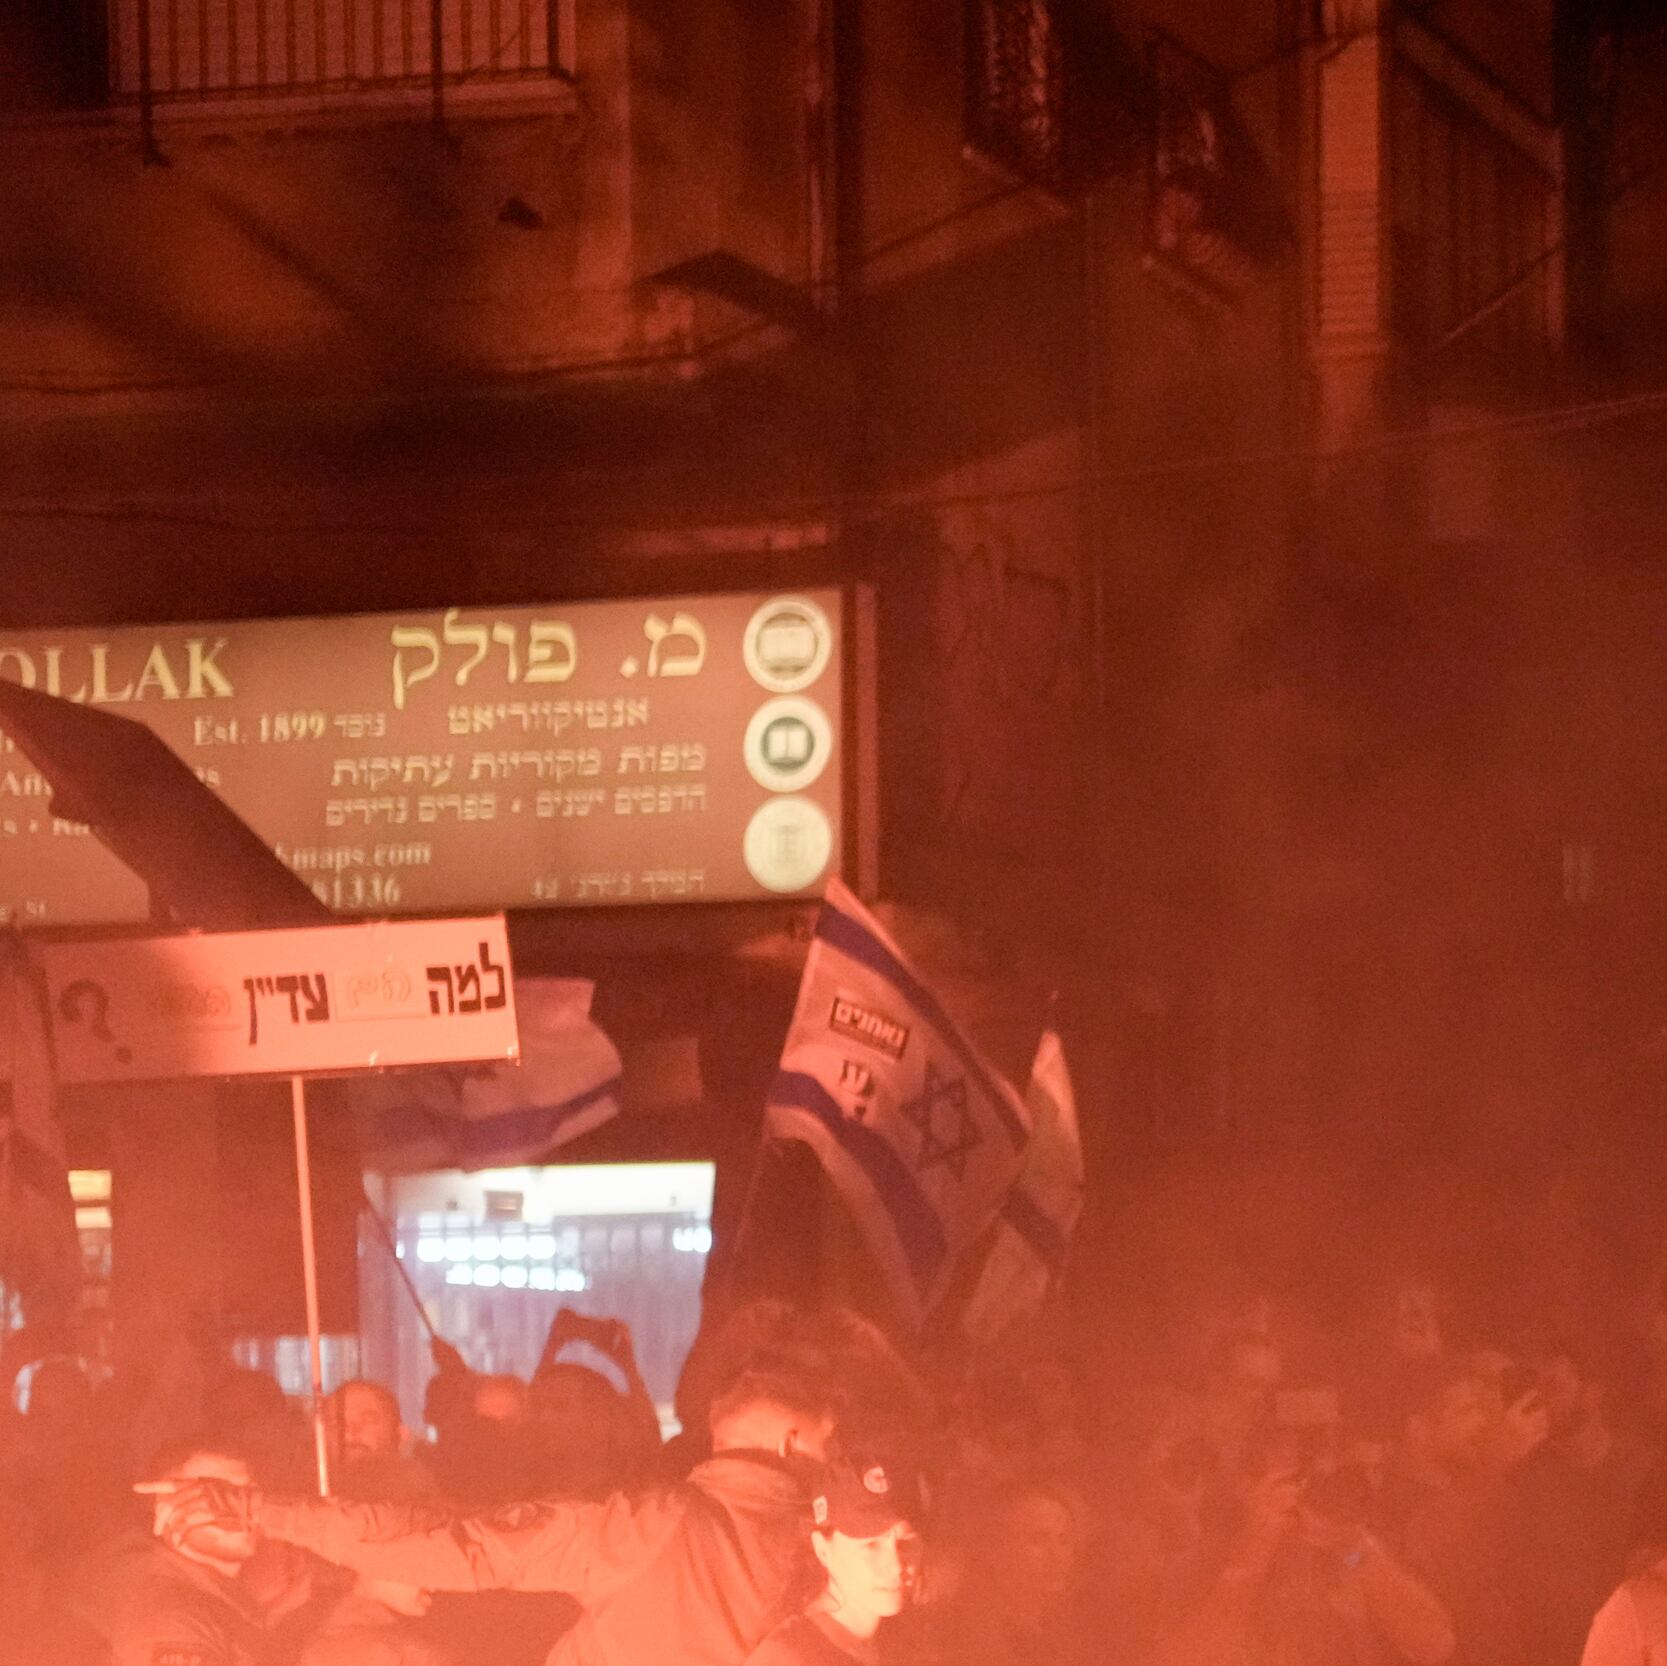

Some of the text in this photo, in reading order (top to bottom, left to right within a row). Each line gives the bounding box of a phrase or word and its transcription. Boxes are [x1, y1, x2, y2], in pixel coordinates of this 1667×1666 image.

[390, 608, 708, 711] מ. פולק
[260, 710, 326, 742] 1899
[330, 742, 708, 793] מפות מקוריות עתיקות
[325, 785, 707, 827] הדפסים ישנים ספרים נדירים
[243, 973, 330, 1046] עדיין
[426, 942, 506, 1016] למה
